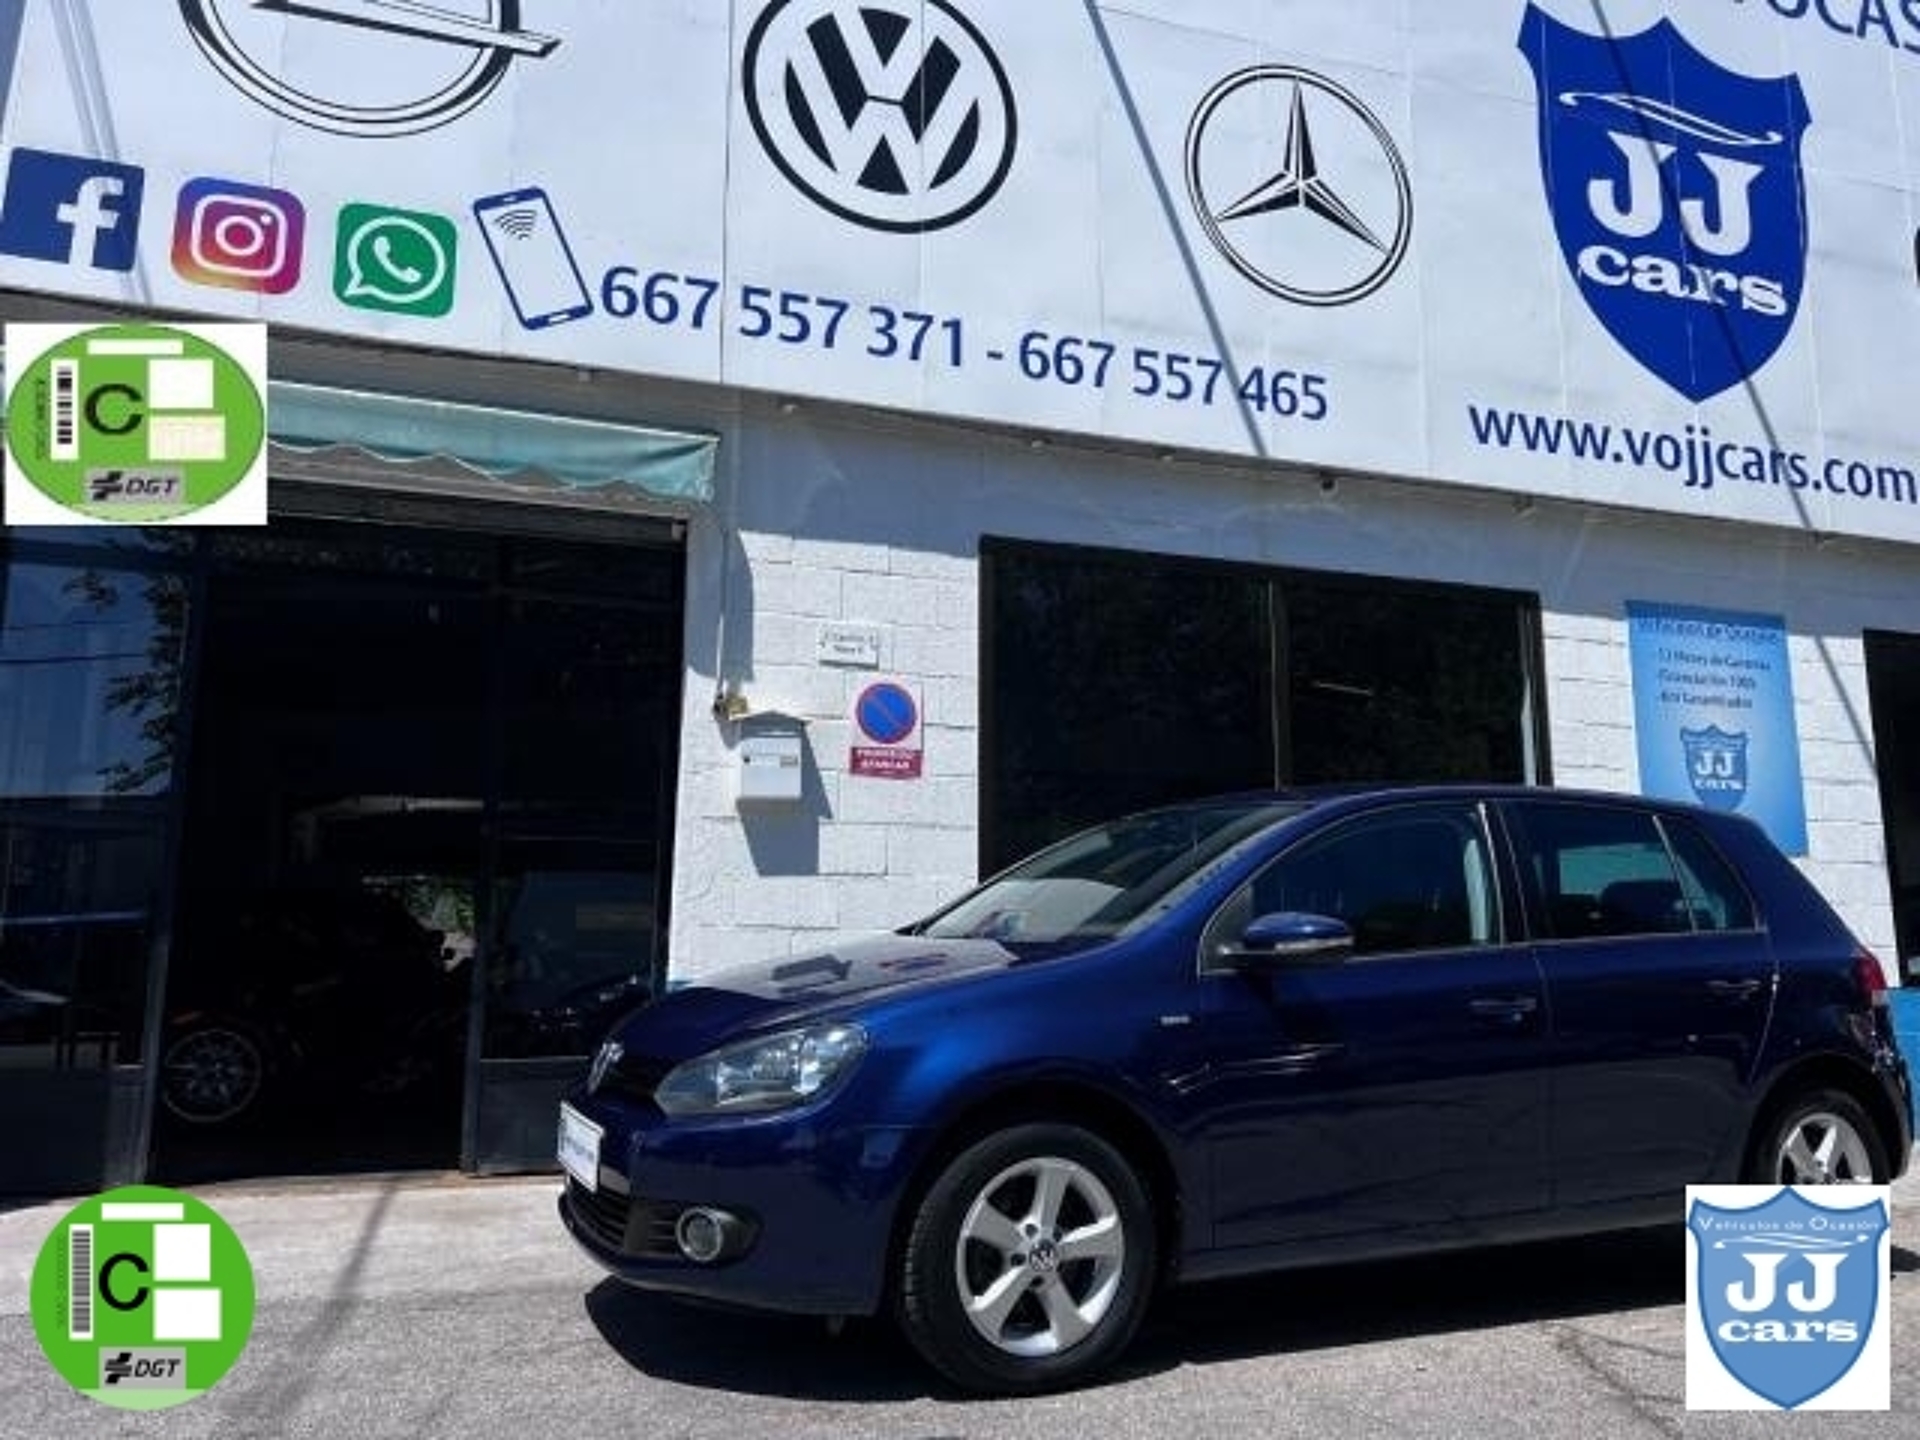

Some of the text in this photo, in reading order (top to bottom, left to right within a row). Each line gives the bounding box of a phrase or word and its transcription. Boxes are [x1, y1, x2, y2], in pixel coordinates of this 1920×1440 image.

[1587, 130, 1765, 257] JJ
[1577, 244, 1788, 317] cars
[600, 265, 719, 330] 667
[739, 286, 848, 349] 557
[866, 305, 964, 368] 371
[1018, 331, 1115, 388] 667
[1132, 350, 1223, 404] 557
[1238, 366, 1329, 421] 465
[1468, 403, 1918, 504] www.vojjcars.com
[1694, 752, 1735, 777] JJ
